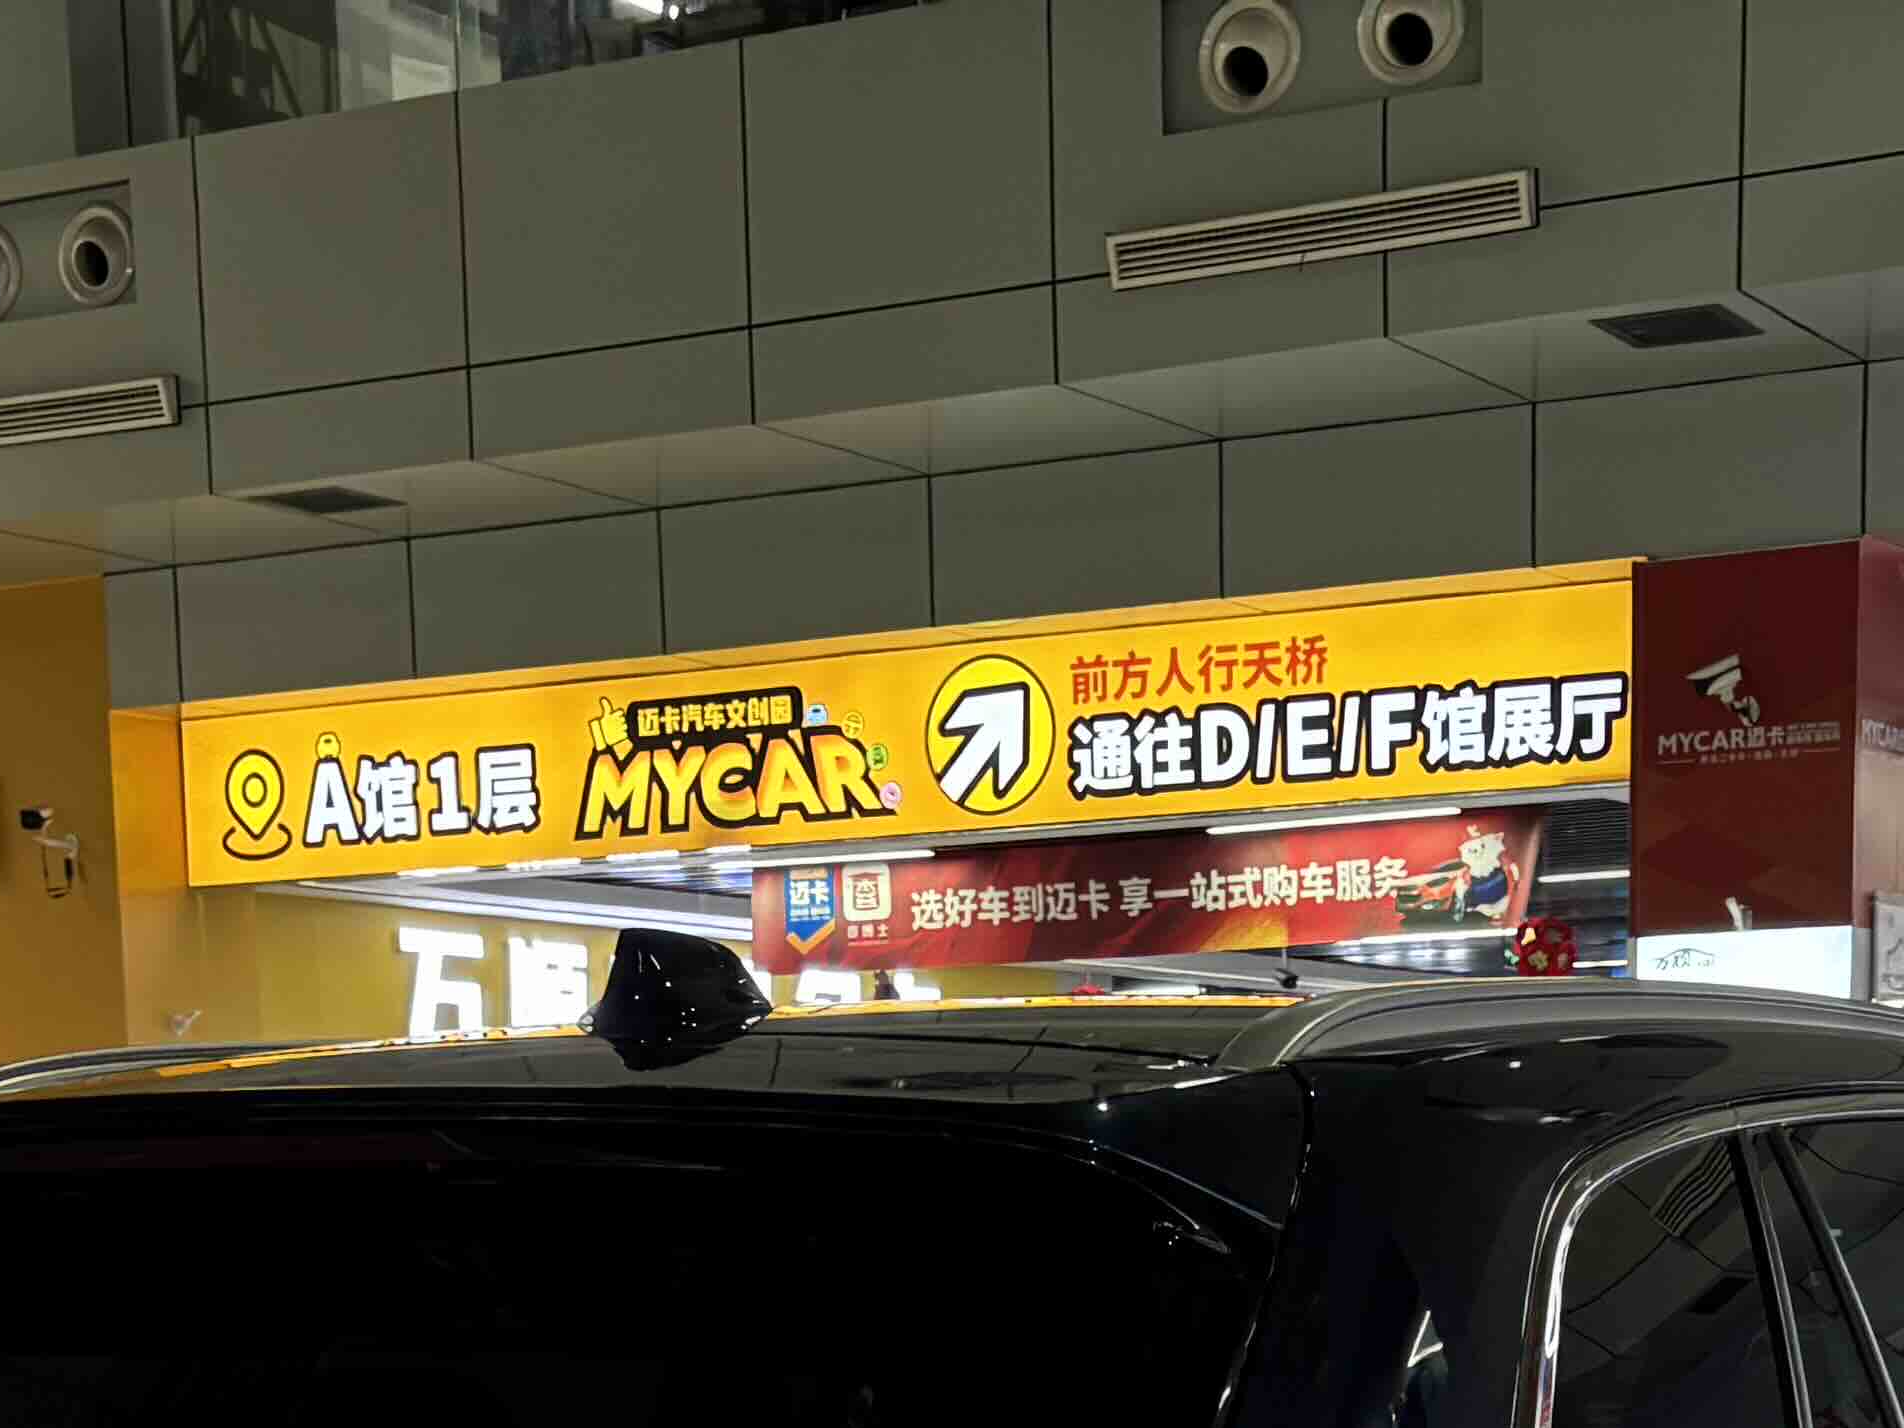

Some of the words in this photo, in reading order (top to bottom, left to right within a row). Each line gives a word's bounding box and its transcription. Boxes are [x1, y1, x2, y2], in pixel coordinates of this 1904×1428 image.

[1071, 636, 1328, 704] 前方人行天桥
[637, 695, 792, 737] 迈卡汽车文创园
[1073, 677, 1626, 797] 通往D/E/F馆展厅
[305, 745, 540, 846] A馆1层
[578, 728, 894, 840] MYCAR
[911, 880, 1110, 931] 选好车到迈卡
[1121, 856, 1409, 917] 享一站式购车服务
